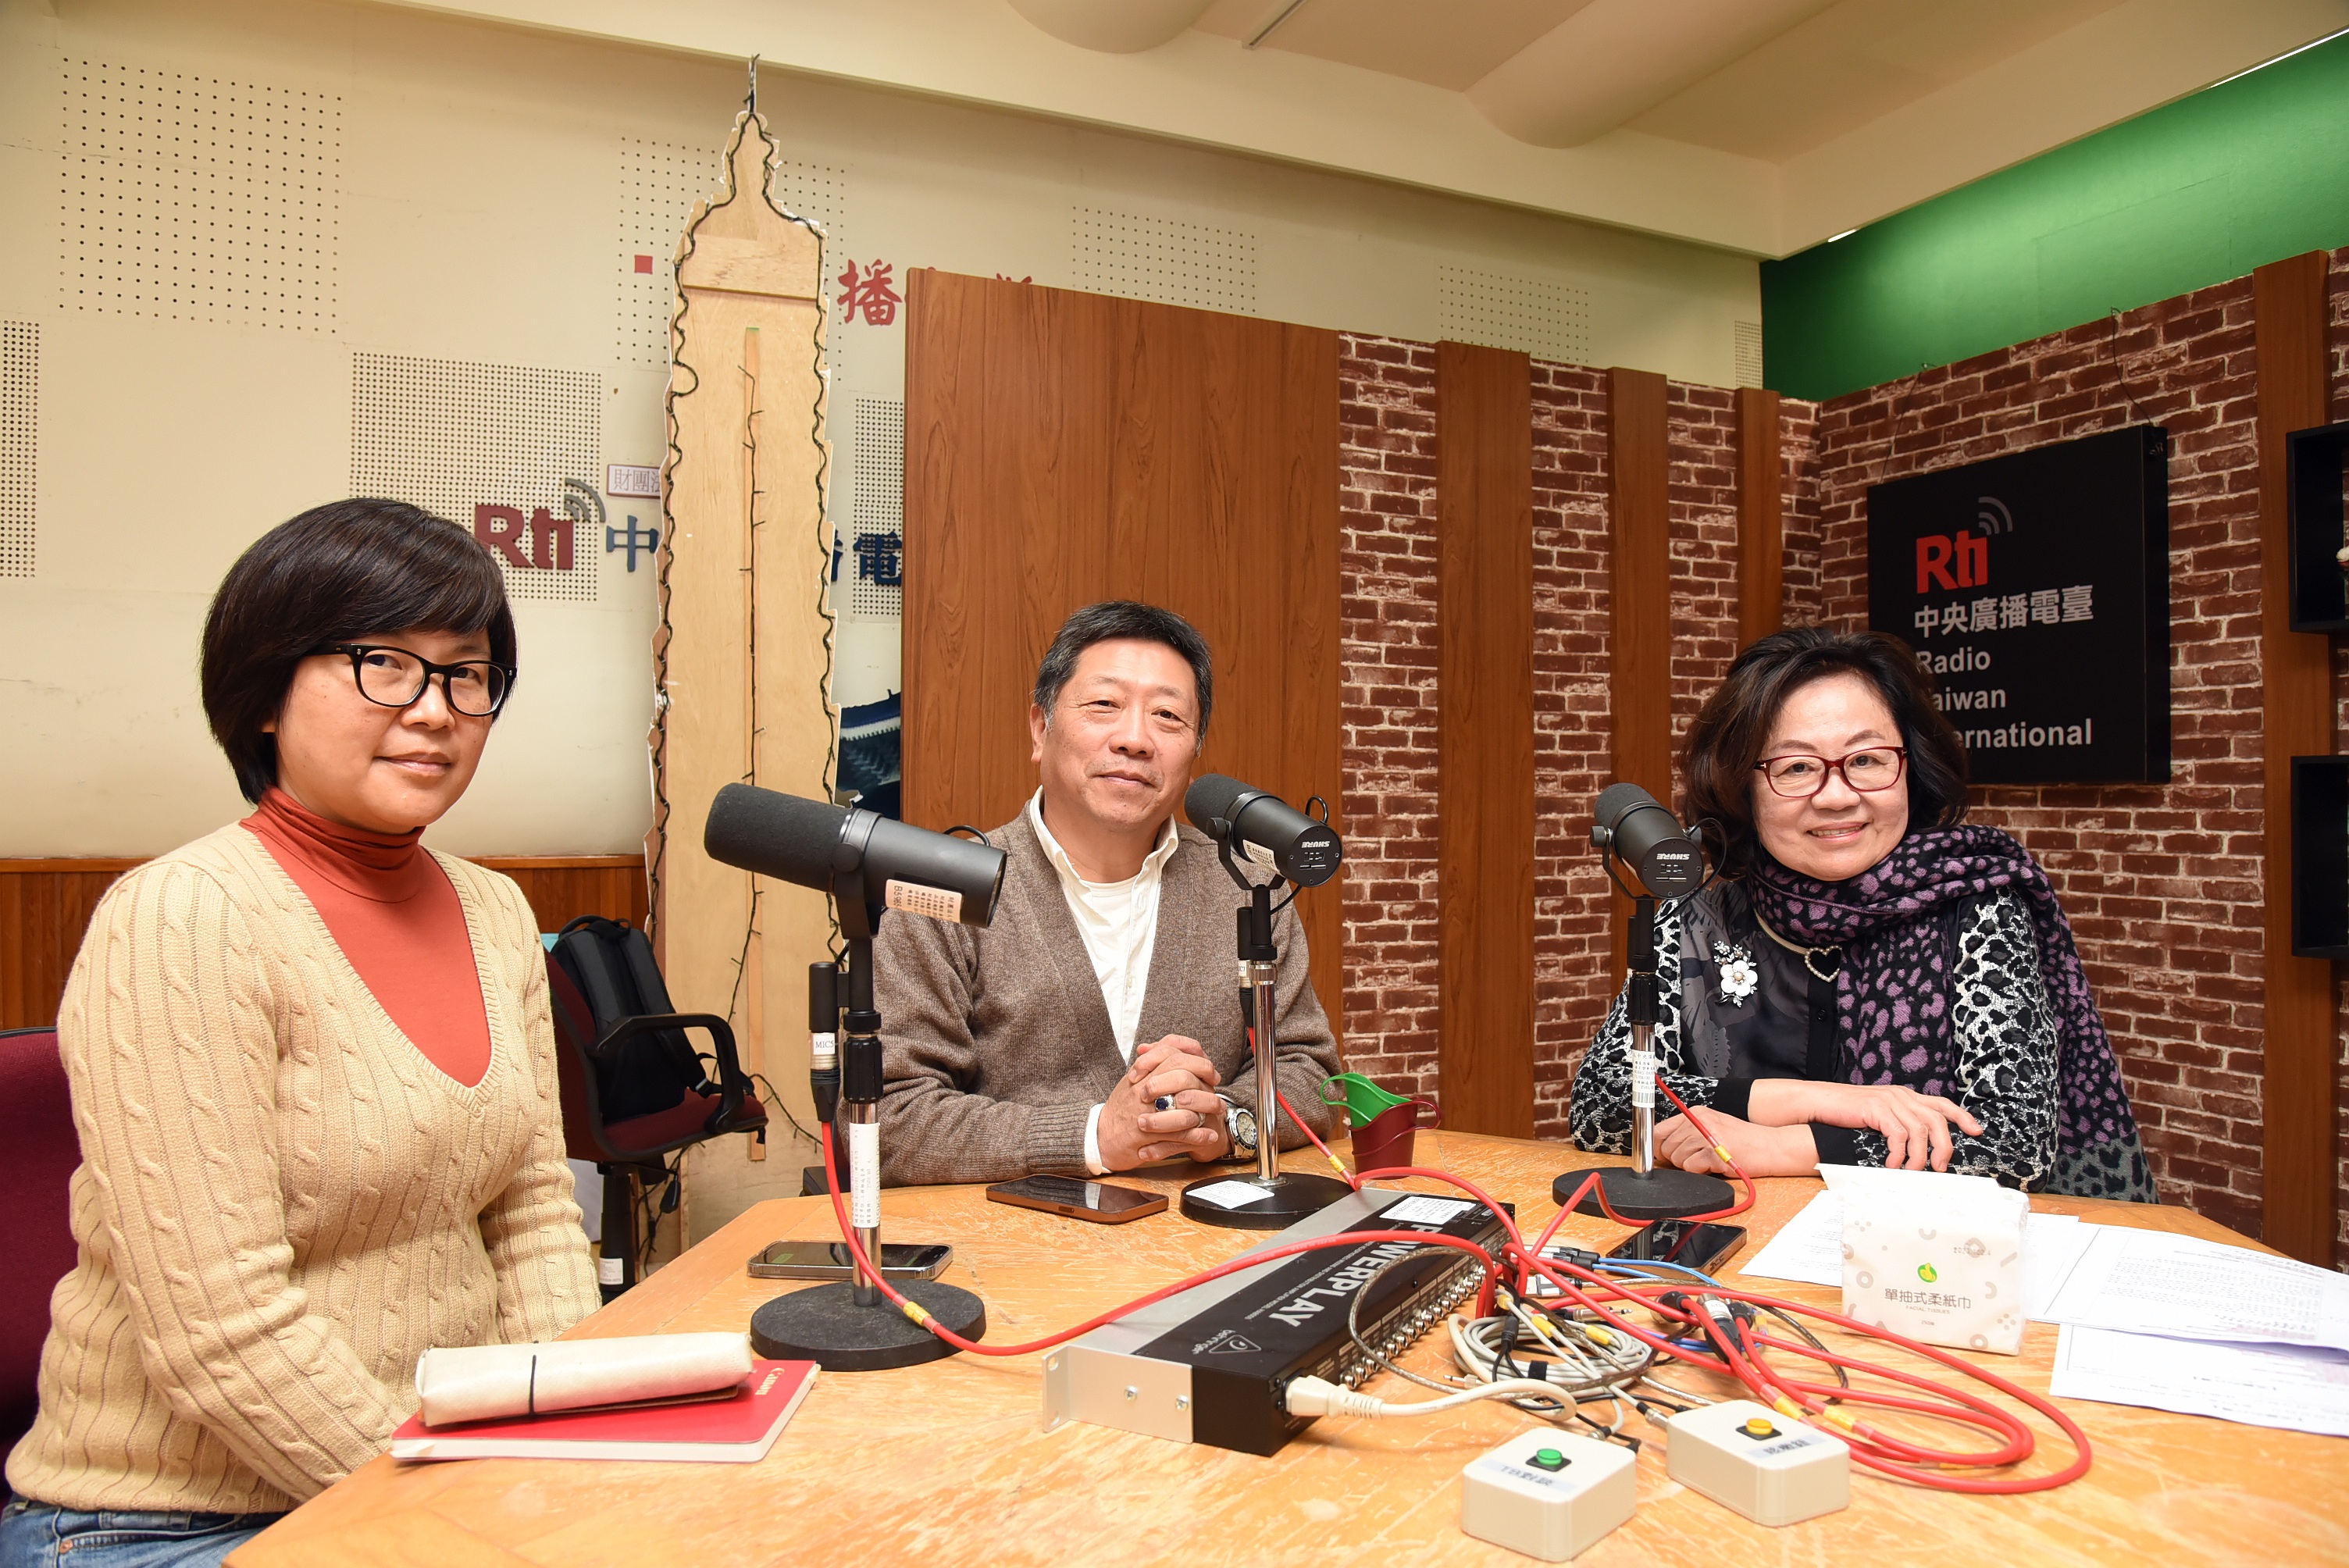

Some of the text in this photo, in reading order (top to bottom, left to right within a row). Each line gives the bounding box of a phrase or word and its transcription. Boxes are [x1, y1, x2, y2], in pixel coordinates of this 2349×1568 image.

[836, 258, 902, 326] 播
[475, 504, 574, 570] Rti
[831, 529, 903, 587] 電
[1916, 529, 1988, 594] Rti
[1914, 584, 2094, 639] 中央廣播電臺
[1916, 646, 1991, 675] Radio
[1931, 686, 2007, 711] aiwan
[1301, 840, 1331, 850] SHURE
[814, 1040, 835, 1049] MIC5
[1884, 1288, 1972, 1310] 單抽式柔紙巾
[754, 1367, 785, 1395] Canon
